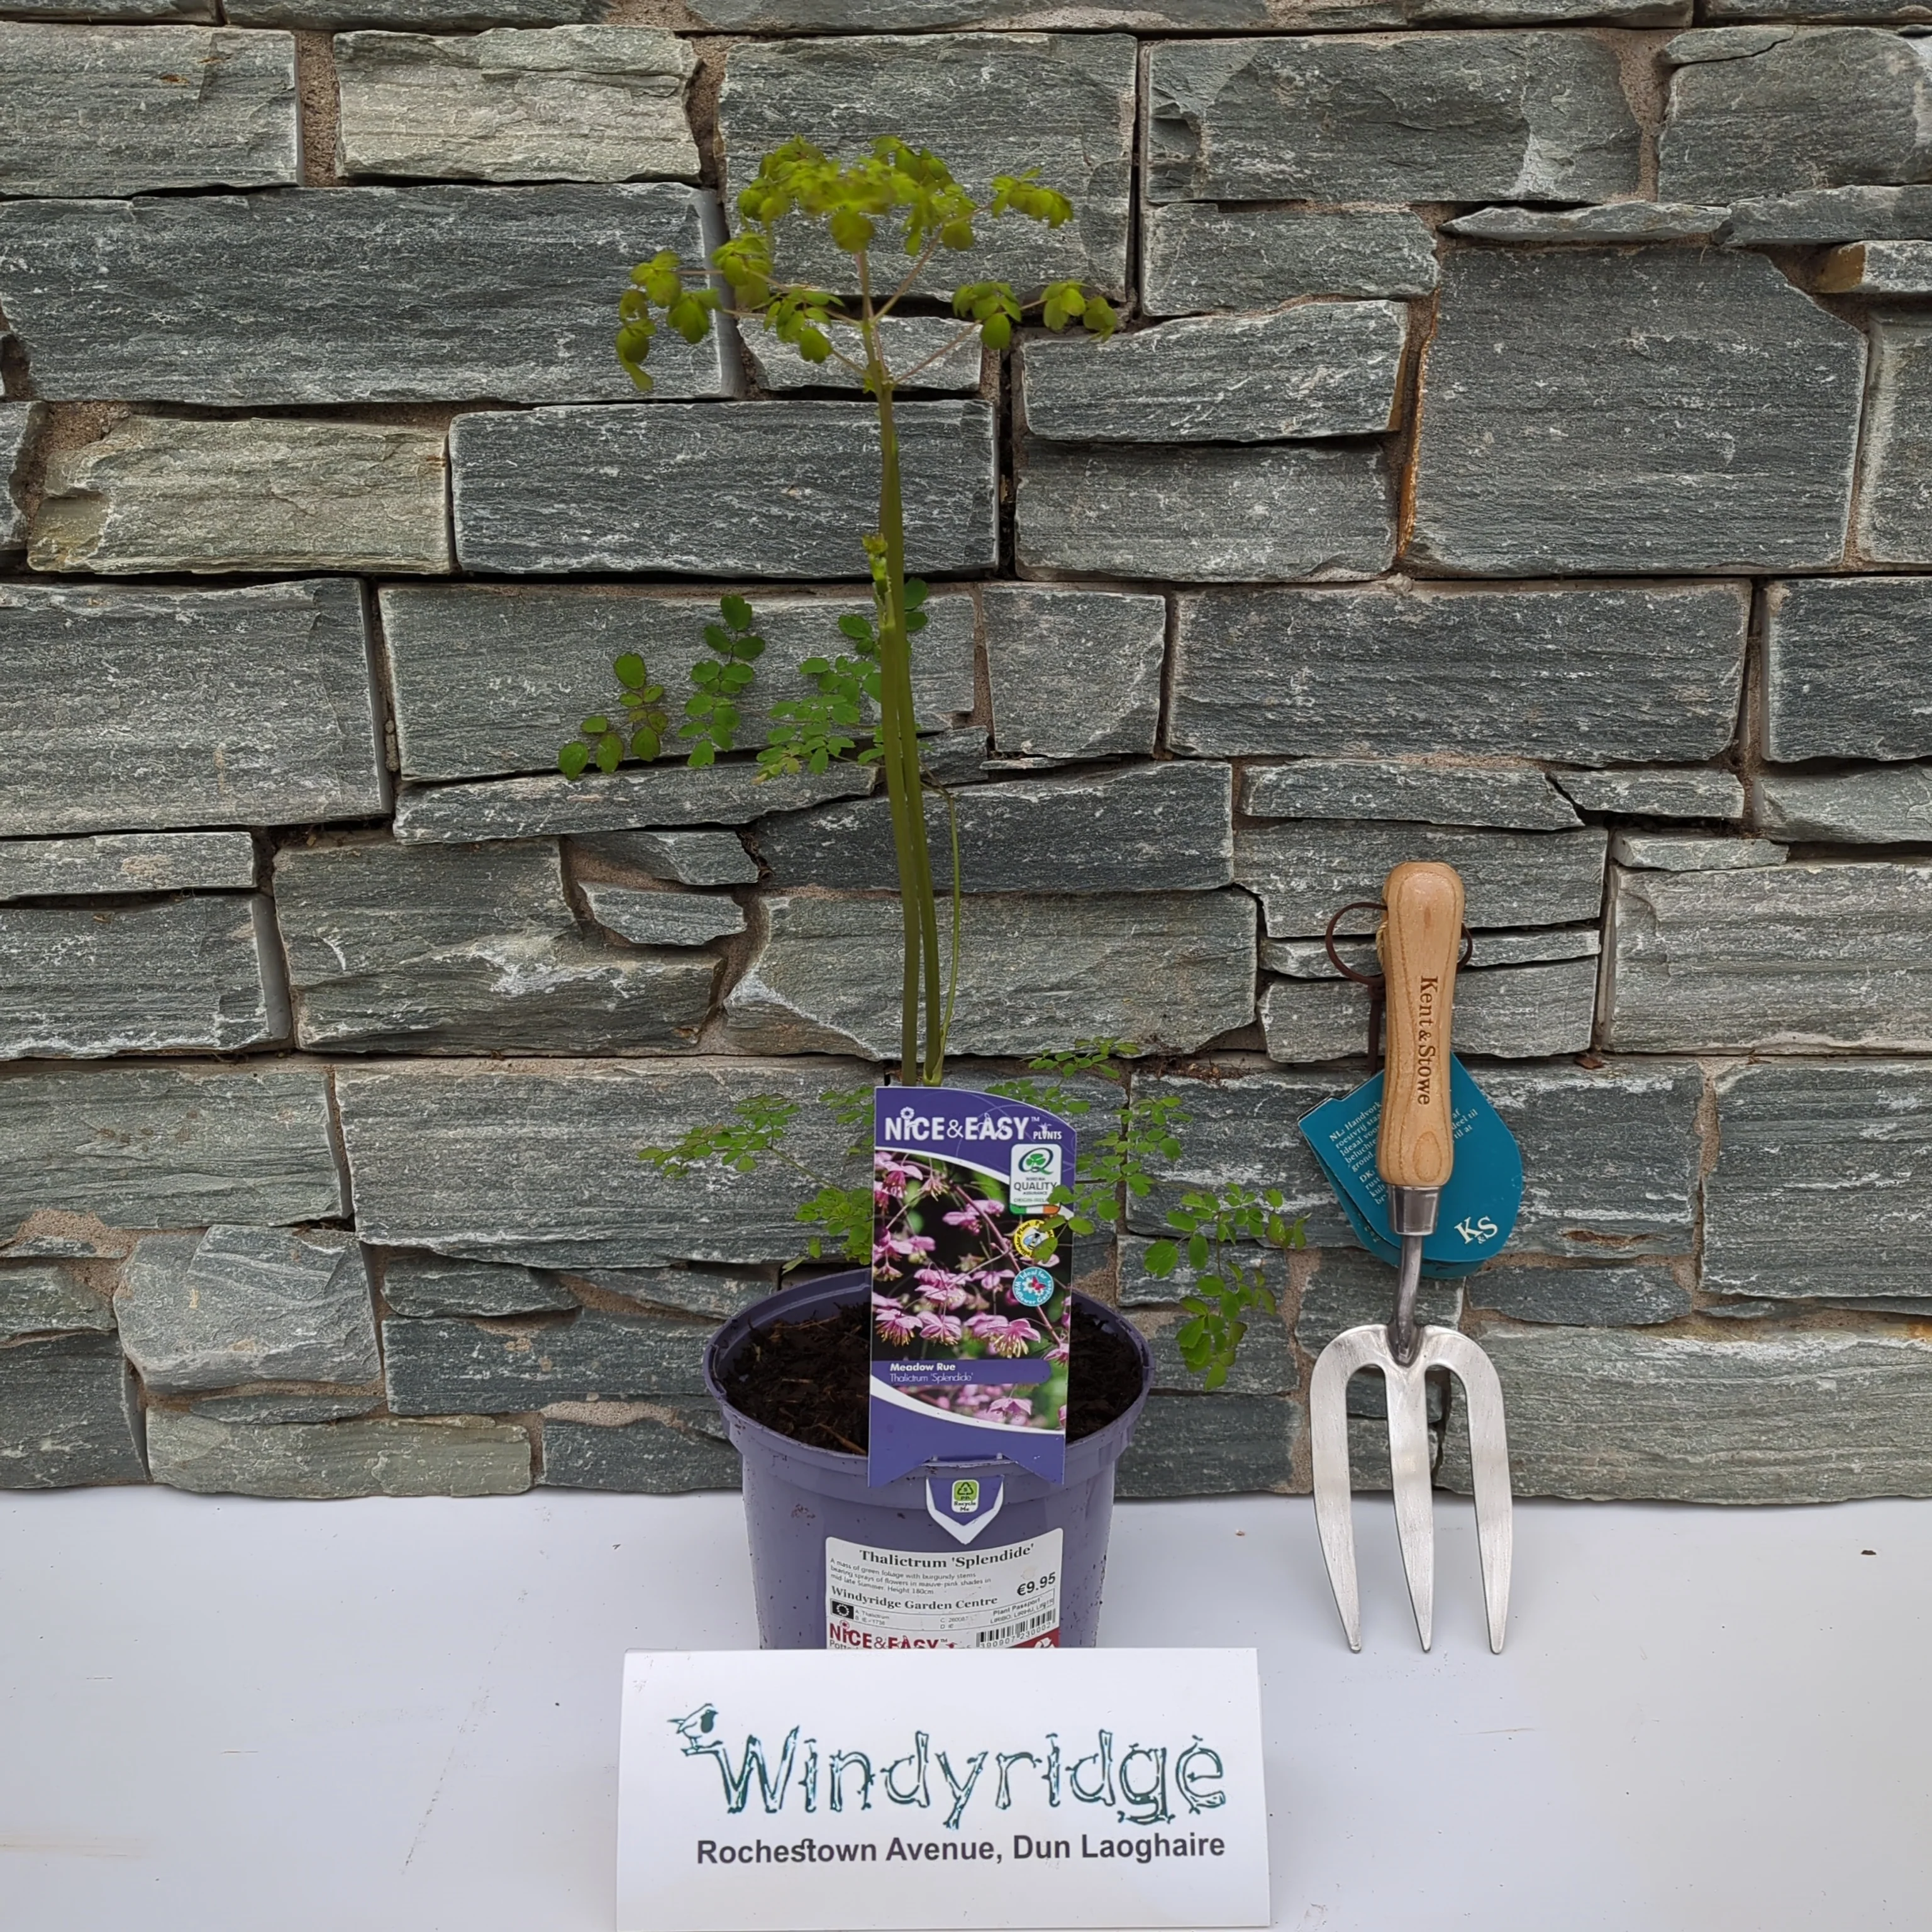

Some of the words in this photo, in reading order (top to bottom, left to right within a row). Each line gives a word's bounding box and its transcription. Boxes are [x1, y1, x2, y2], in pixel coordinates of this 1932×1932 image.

[1345, 1138, 1378, 1163] beluchte
[1013, 1182, 1057, 1192] QUALITY
[1019, 1269, 1038, 1280] Ideal
[1038, 1269, 1048, 1280] for
[890, 1363, 934, 1372] Meadow
[936, 1363, 956, 1372] Rue
[890, 1374, 928, 1382] Thalictrum
[931, 1373, 974, 1384] 'Splendide'
[859, 1550, 947, 1568] Thalictrum
[952, 1543, 1034, 1569] 'Splendide'
[830, 1565, 853, 1578] bearing
[855, 1574, 874, 1583] sprays
[885, 1578, 908, 1586] flowers
[836, 1560, 852, 1569] mass
[861, 1567, 880, 1575] green
[882, 1570, 904, 1579] foliage
[844, 1576, 856, 1585] late
[887, 1586, 910, 1594] Height
[1017, 1571, 1057, 1596] €9.95
[831, 1585, 901, 1609] Windyridge
[905, 1599, 952, 1610] Garden
[956, 1597, 998, 1609] Centre
[993, 1607, 1011, 1616] Plant
[1012, 1597, 1040, 1611] Passport
[684, 1726, 1226, 1829] Windyridge
[697, 1838, 877, 1863] Rochestown
[886, 1837, 1002, 1864] Avenue,
[1013, 1834, 1070, 1860] Dun
[1082, 1831, 1224, 1863] Laoghaire
